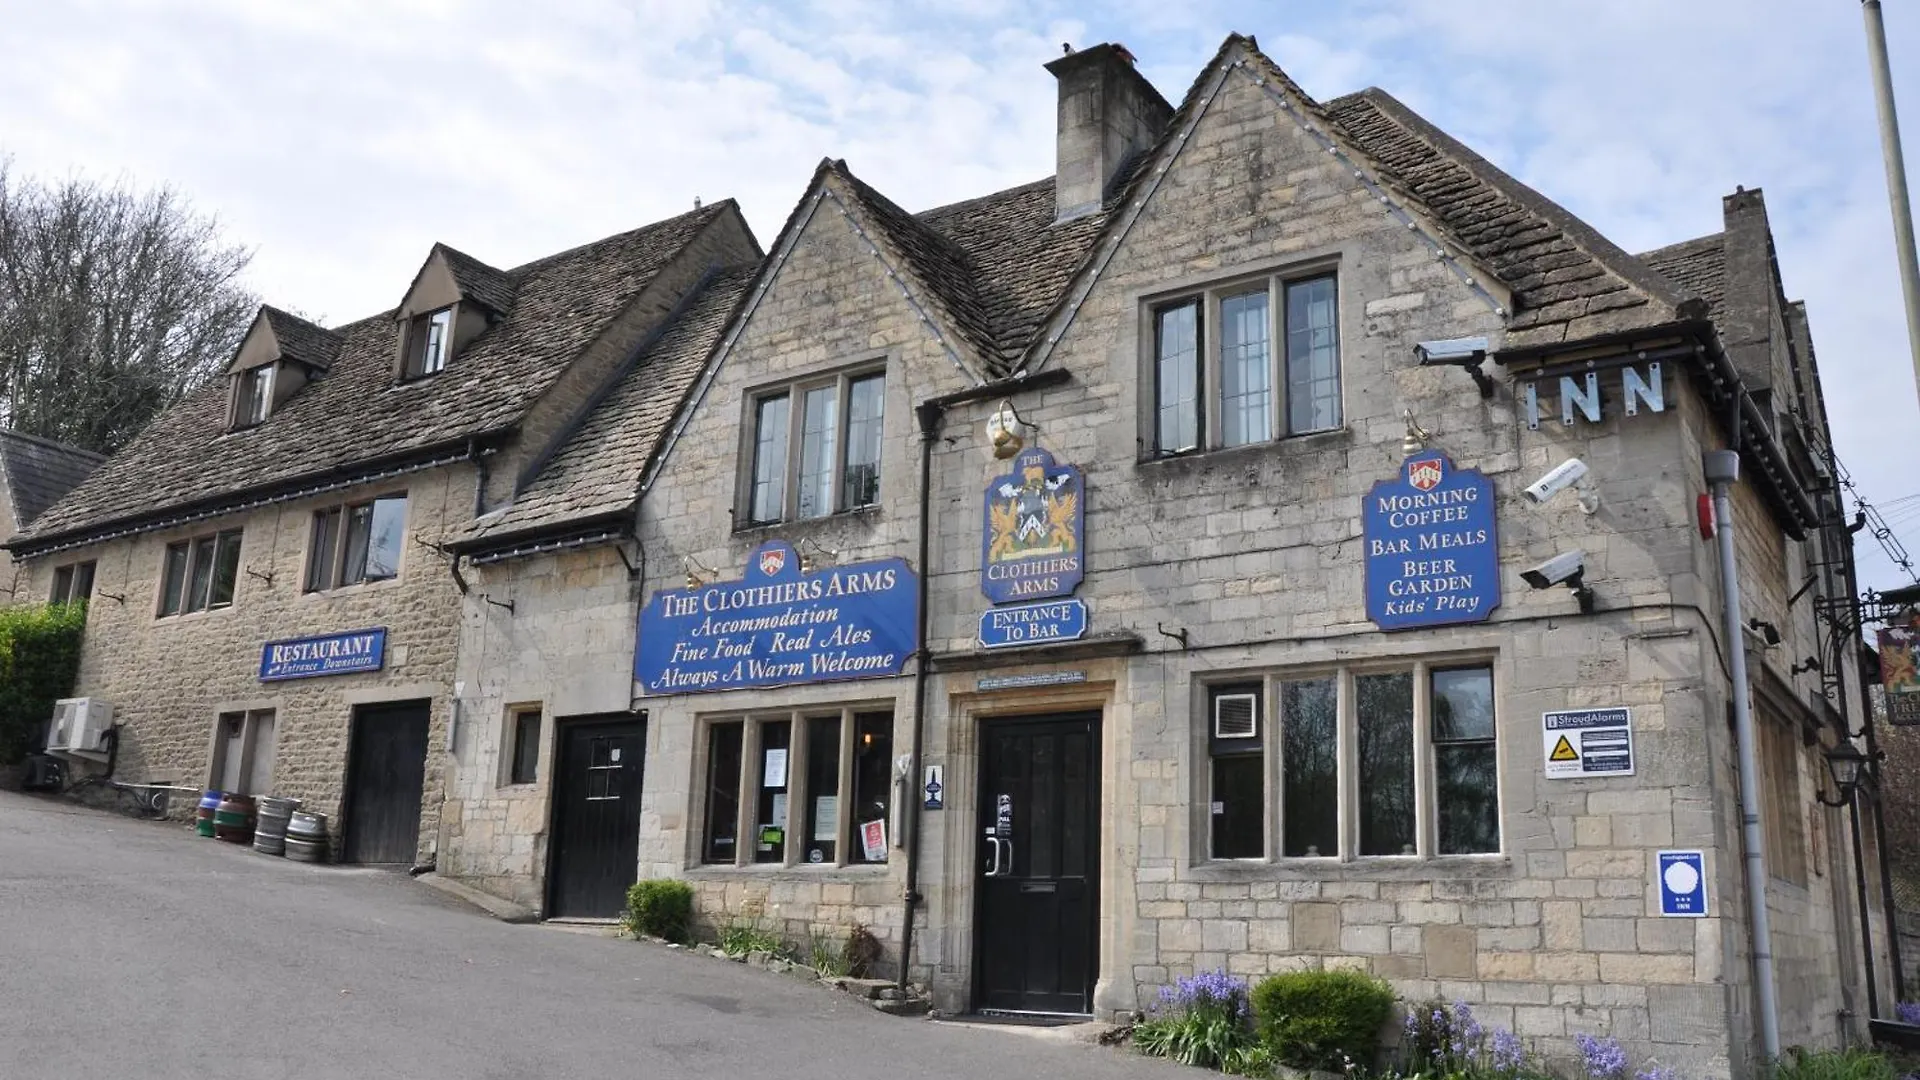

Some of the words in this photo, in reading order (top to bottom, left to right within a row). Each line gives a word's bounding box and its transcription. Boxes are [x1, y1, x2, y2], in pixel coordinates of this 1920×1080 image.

[1526, 362, 1665, 430] INN
[1021, 454, 1044, 466] THE
[1379, 487, 1478, 513] MORNING
[1389, 505, 1469, 528] COFFEE
[1371, 538, 1412, 556] BAR
[1419, 529, 1486, 550] MEALS
[988, 557, 1078, 580] CLOTHIERS
[1403, 559, 1457, 577] BEER
[662, 594, 699, 618] THE
[703, 578, 823, 612] CLOTHIERS
[825, 569, 896, 597] ARMS
[1009, 577, 1059, 595] ARMS
[1389, 575, 1473, 596] GARDEN
[1385, 596, 1430, 615] Kids'
[1435, 595, 1480, 613] Play
[691, 603, 839, 637] Accommodation
[993, 605, 1071, 629] ENTRANCE
[1029, 623, 1060, 639] BAR
[271, 636, 374, 664] RESTAURANT
[670, 642, 709, 663] Fine
[712, 635, 756, 659] Food
[769, 628, 815, 653] Real
[820, 623, 872, 648] Ales
[280, 661, 319, 675] Entrance
[322, 653, 373, 670] Downstairs
[651, 667, 719, 689] Always
[722, 660, 743, 682] A
[748, 657, 805, 679] Warm
[811, 650, 895, 674] Welcome
[1558, 713, 1626, 725] StroudAlarms
